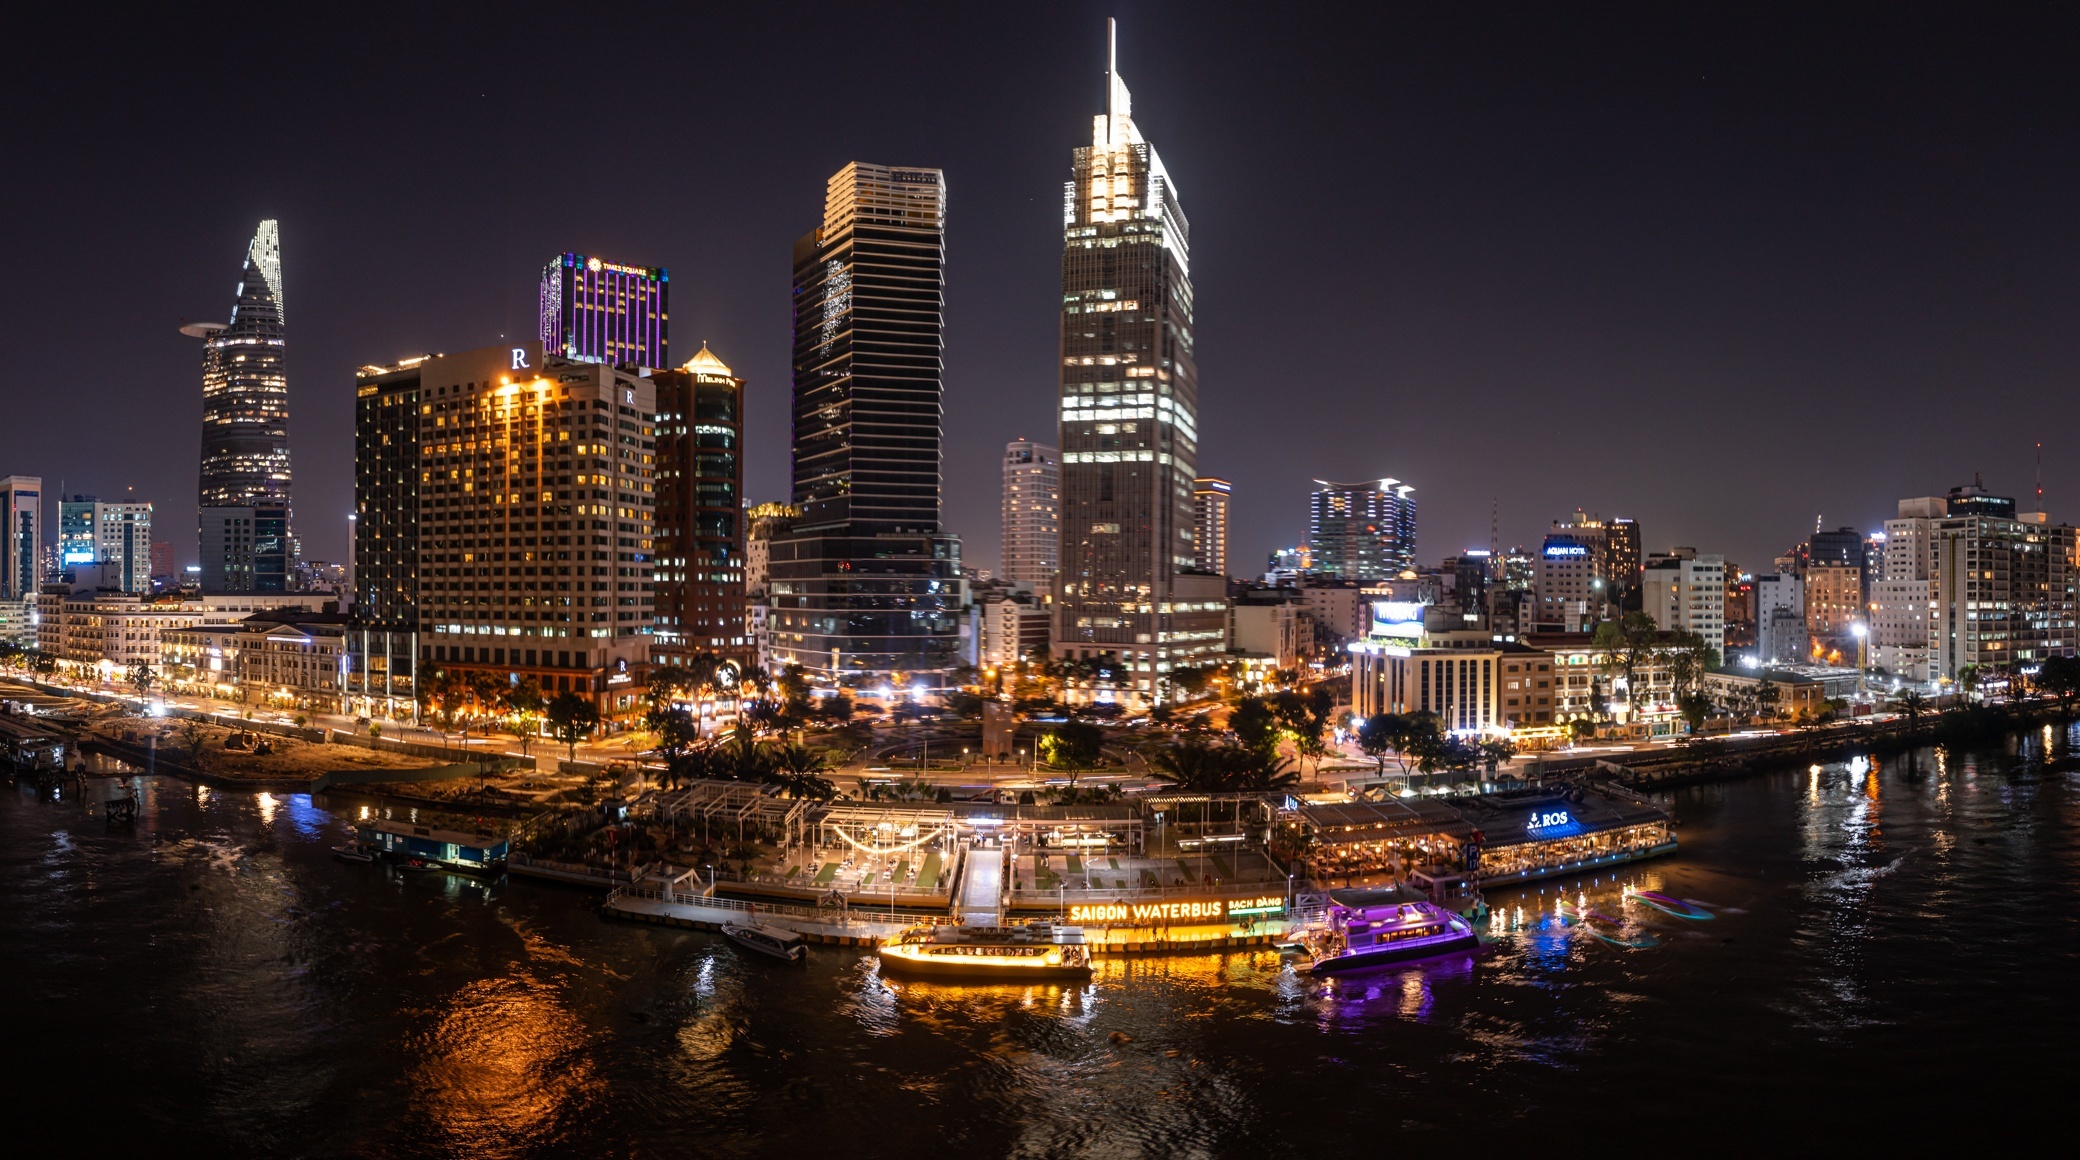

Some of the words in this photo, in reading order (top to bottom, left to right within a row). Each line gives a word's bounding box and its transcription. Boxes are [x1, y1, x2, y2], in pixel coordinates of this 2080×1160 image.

[603, 263, 622, 272] TIMES
[622, 266, 647, 276] SQUARE
[512, 348, 530, 370] R
[626, 389, 634, 404] R
[620, 660, 626, 671] R
[1542, 812, 1568, 827] ROS
[1470, 846, 1477, 855] P
[1071, 905, 1127, 921] SAIGON
[1133, 902, 1221, 919] WATERBUS
